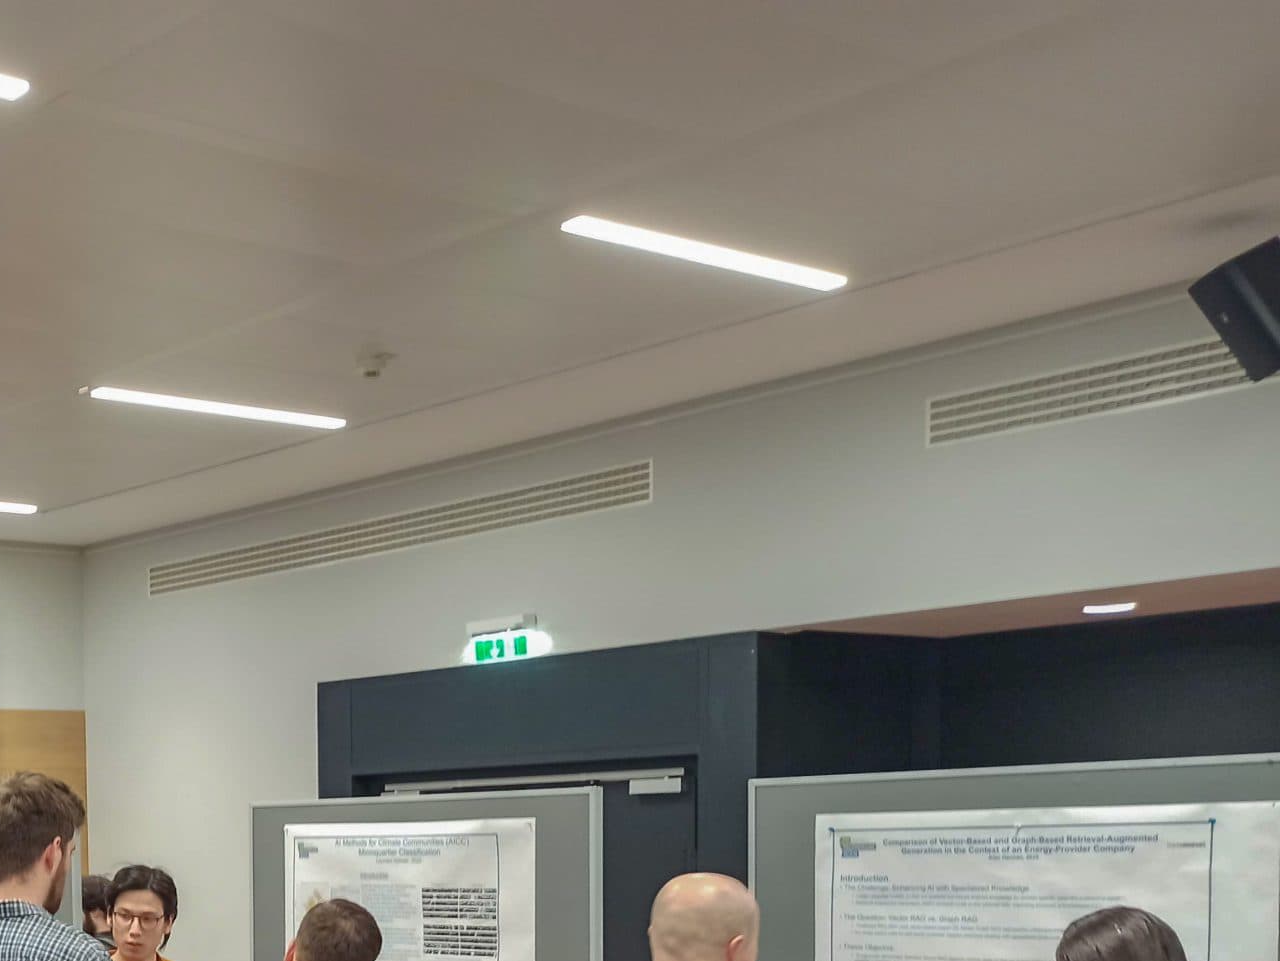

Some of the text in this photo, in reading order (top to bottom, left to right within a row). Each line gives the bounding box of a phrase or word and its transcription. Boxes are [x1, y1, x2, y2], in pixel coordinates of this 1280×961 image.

[882, 837, 927, 847] Comparison
[929, 836, 937, 845] of
[994, 836, 1008, 844] and
[1066, 833, 1158, 845] Retrieval-Augmented
[954, 846, 966, 854] the
[1093, 844, 1135, 854] Company
[840, 874, 888, 883] Introduction
